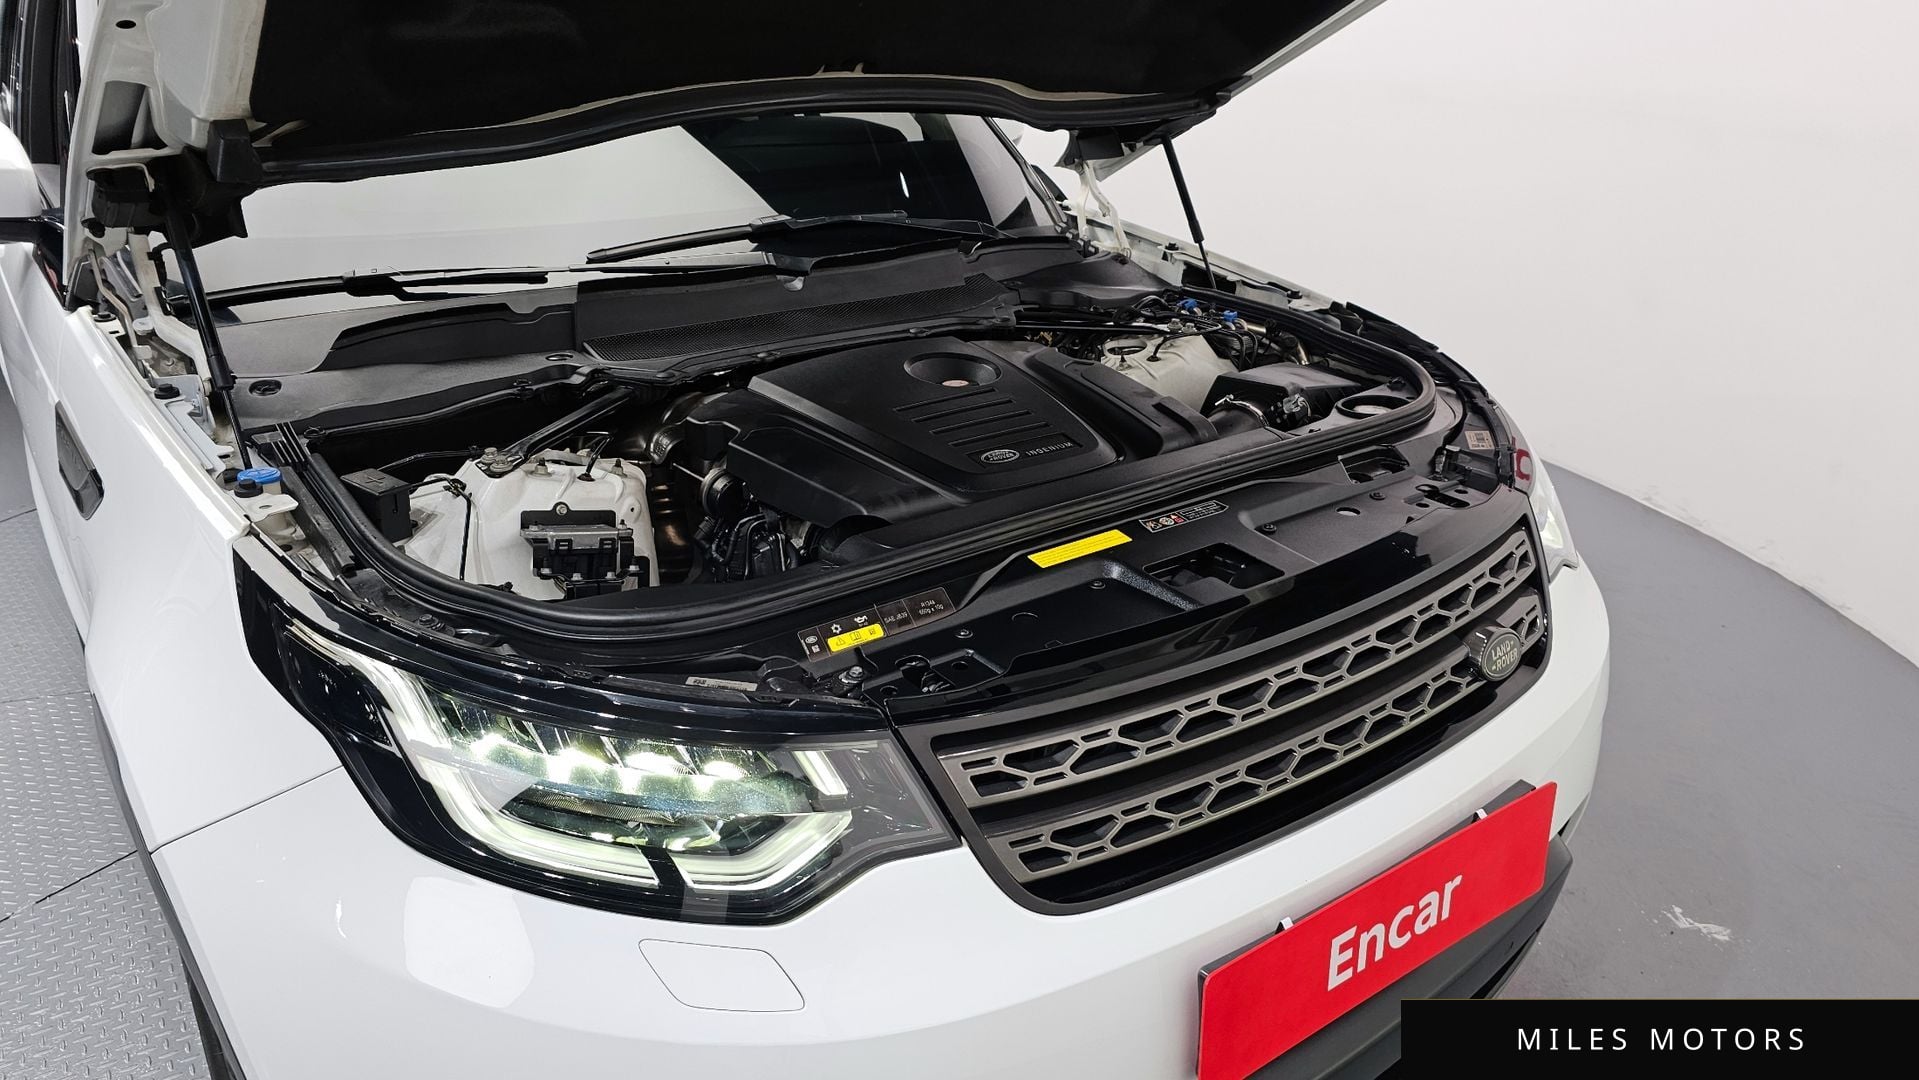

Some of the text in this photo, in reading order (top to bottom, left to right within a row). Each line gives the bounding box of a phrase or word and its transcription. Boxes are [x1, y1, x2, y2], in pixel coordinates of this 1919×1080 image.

[1025, 441, 1073, 457] INGENIUM
[1491, 640, 1511, 660] LAND
[1496, 647, 1518, 671] ROVER
[1327, 874, 1463, 992] Encar
